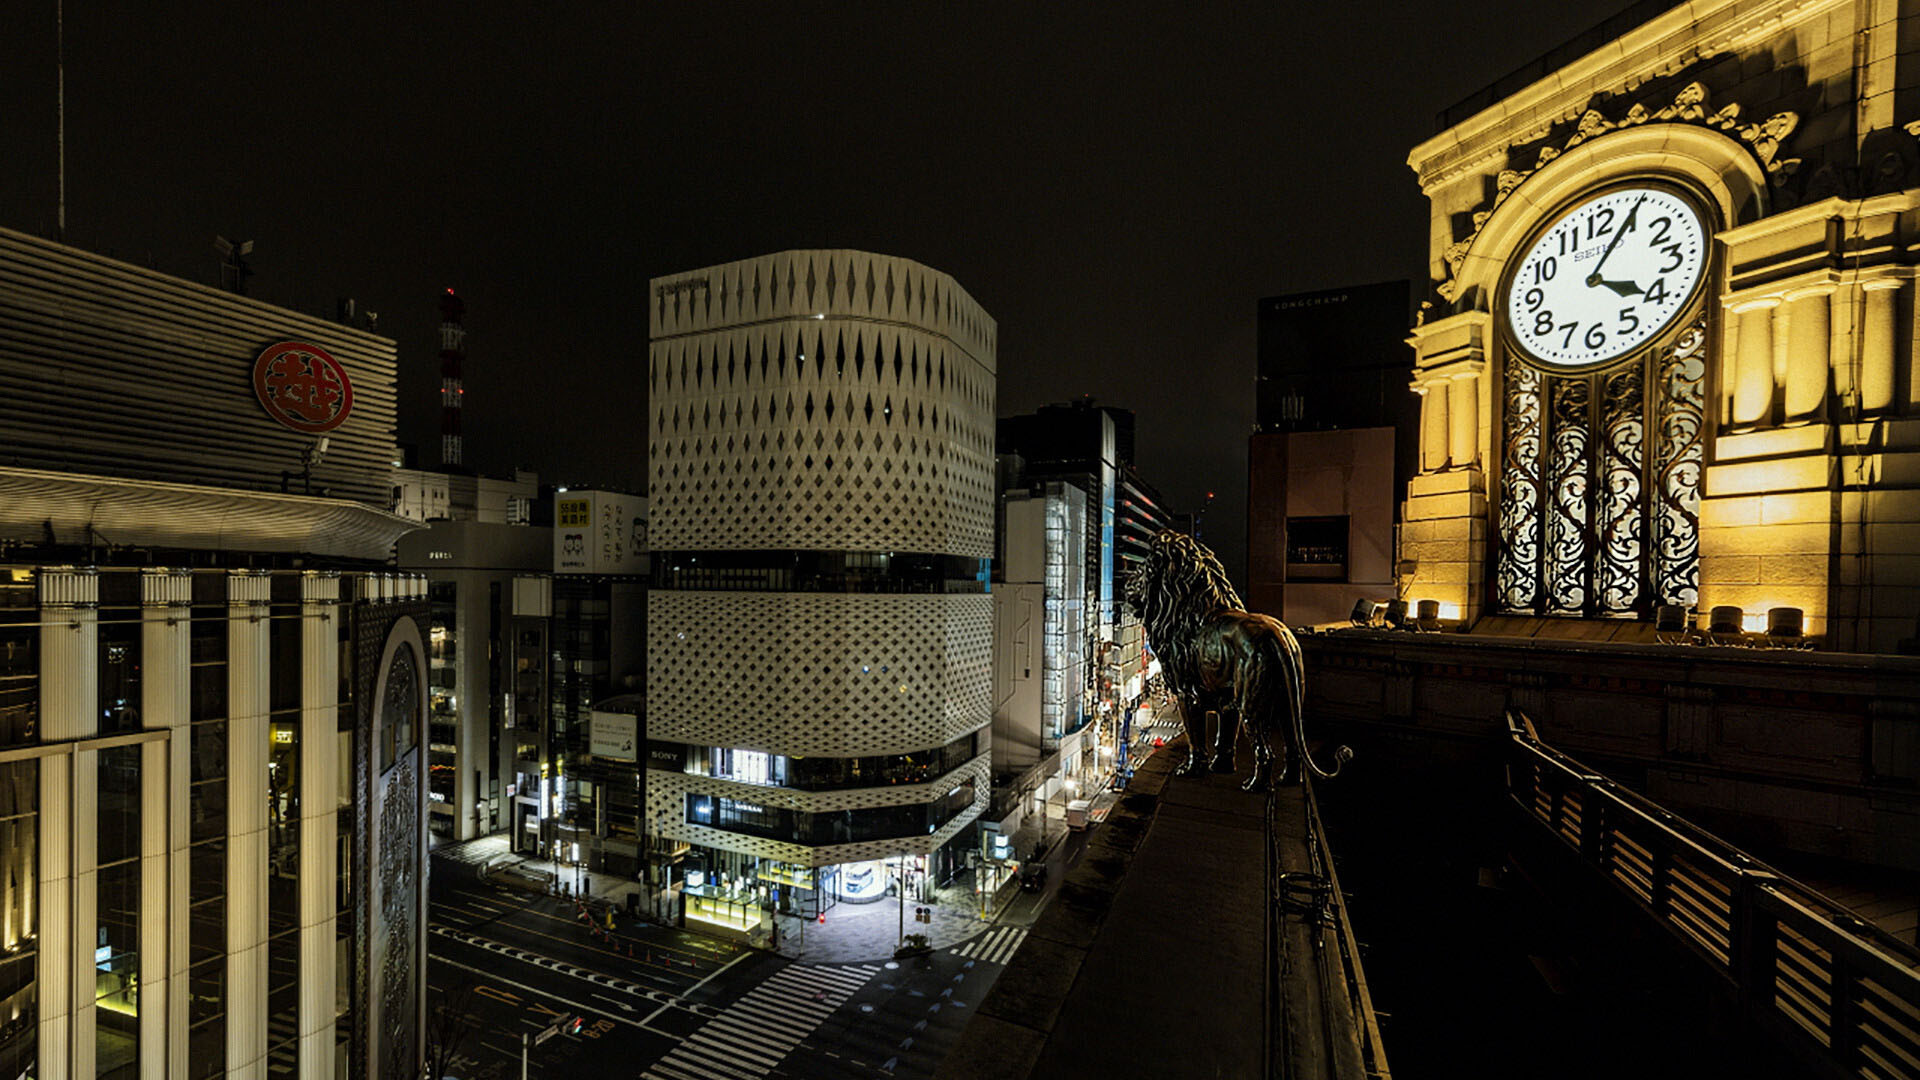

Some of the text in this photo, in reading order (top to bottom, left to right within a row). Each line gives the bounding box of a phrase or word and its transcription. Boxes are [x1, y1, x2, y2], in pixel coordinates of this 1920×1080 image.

[1587, 208, 1614, 240] 12
[1648, 216, 1672, 247] 2
[1559, 226, 1578, 256] 11
[1534, 256, 1557, 285] 10
[1659, 242, 1683, 273] 3
[1525, 287, 1544, 313] 9
[1643, 278, 1670, 305] 4
[1533, 310, 1554, 336] 8
[1617, 306, 1639, 335] 5
[1558, 321, 1579, 349] 7
[1584, 322, 1606, 349] 6
[651, 751, 678, 761] SONY
